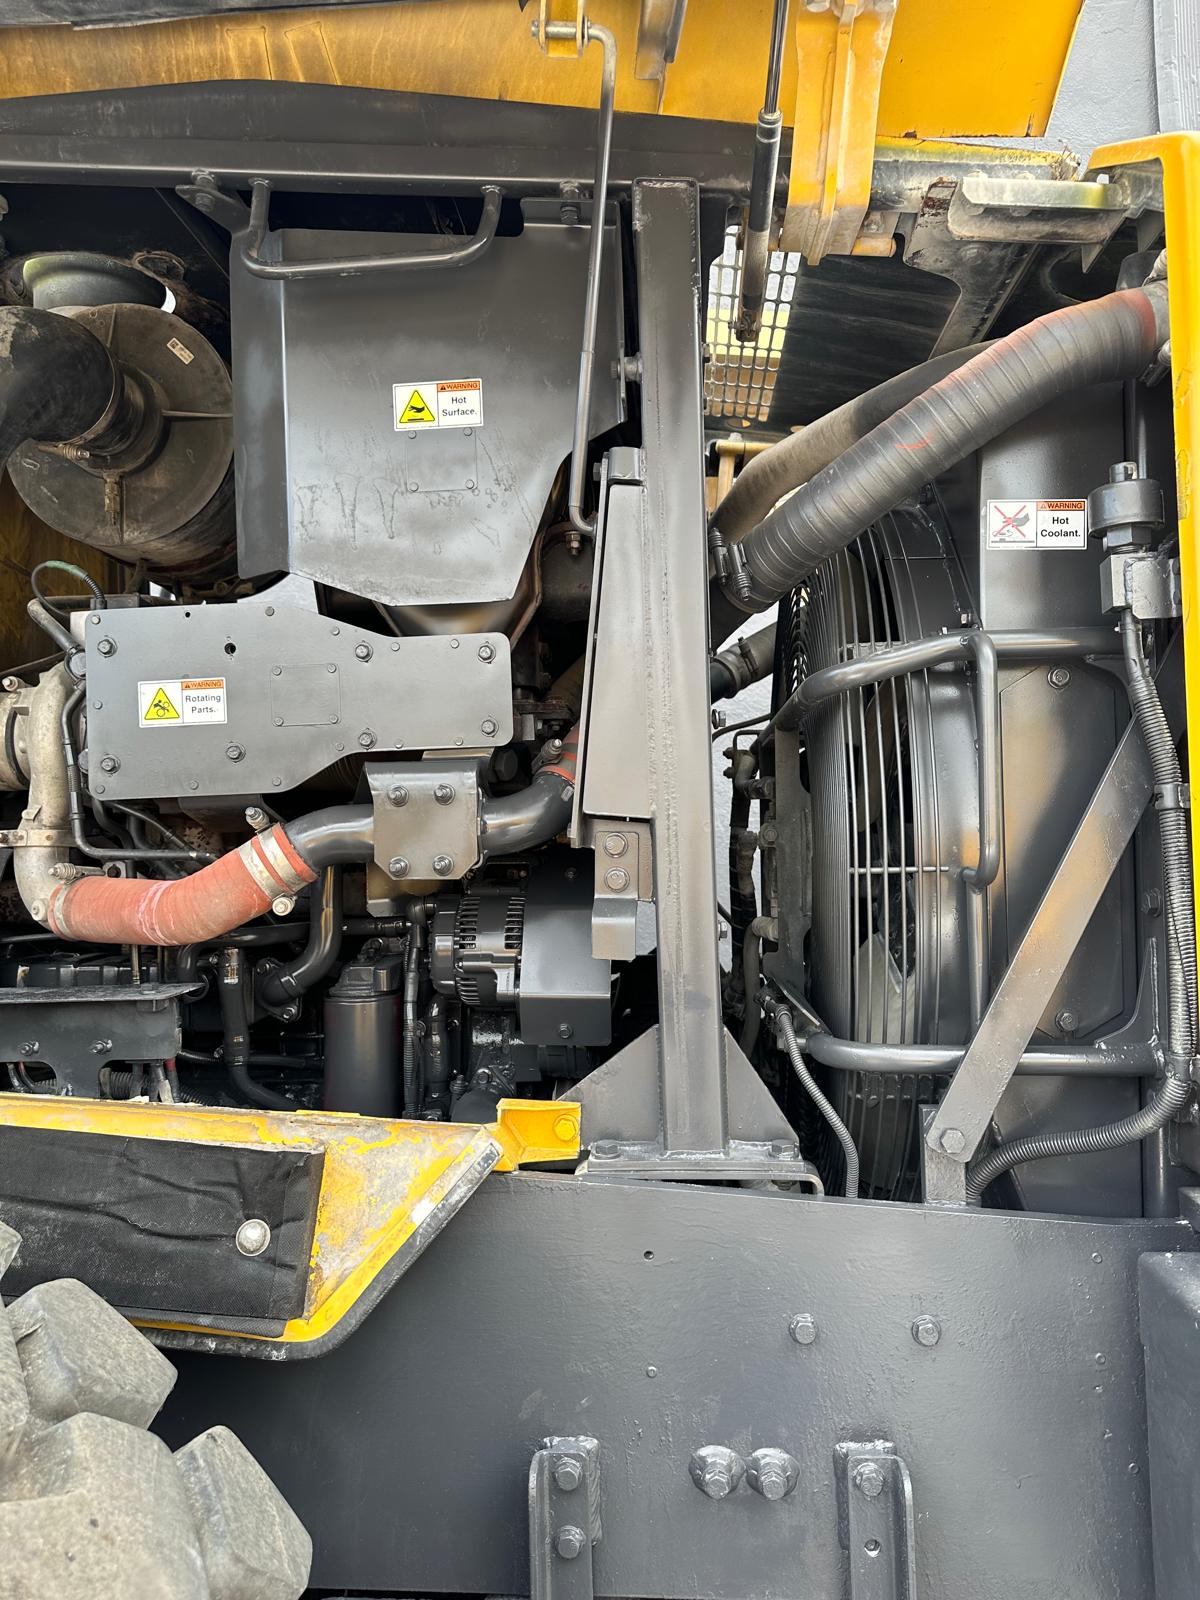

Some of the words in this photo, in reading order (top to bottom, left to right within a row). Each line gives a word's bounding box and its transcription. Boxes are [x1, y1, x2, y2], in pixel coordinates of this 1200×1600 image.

[446, 382, 478, 390] WARNING
[451, 396, 467, 404] Hot
[442, 408, 477, 417] Surface.
[1052, 517, 1069, 525] Hot
[1040, 529, 1081, 537] Coolant.
[191, 680, 222, 688] WARNING
[185, 694, 221, 703] Rotating
[191, 706, 216, 714] Parts.
